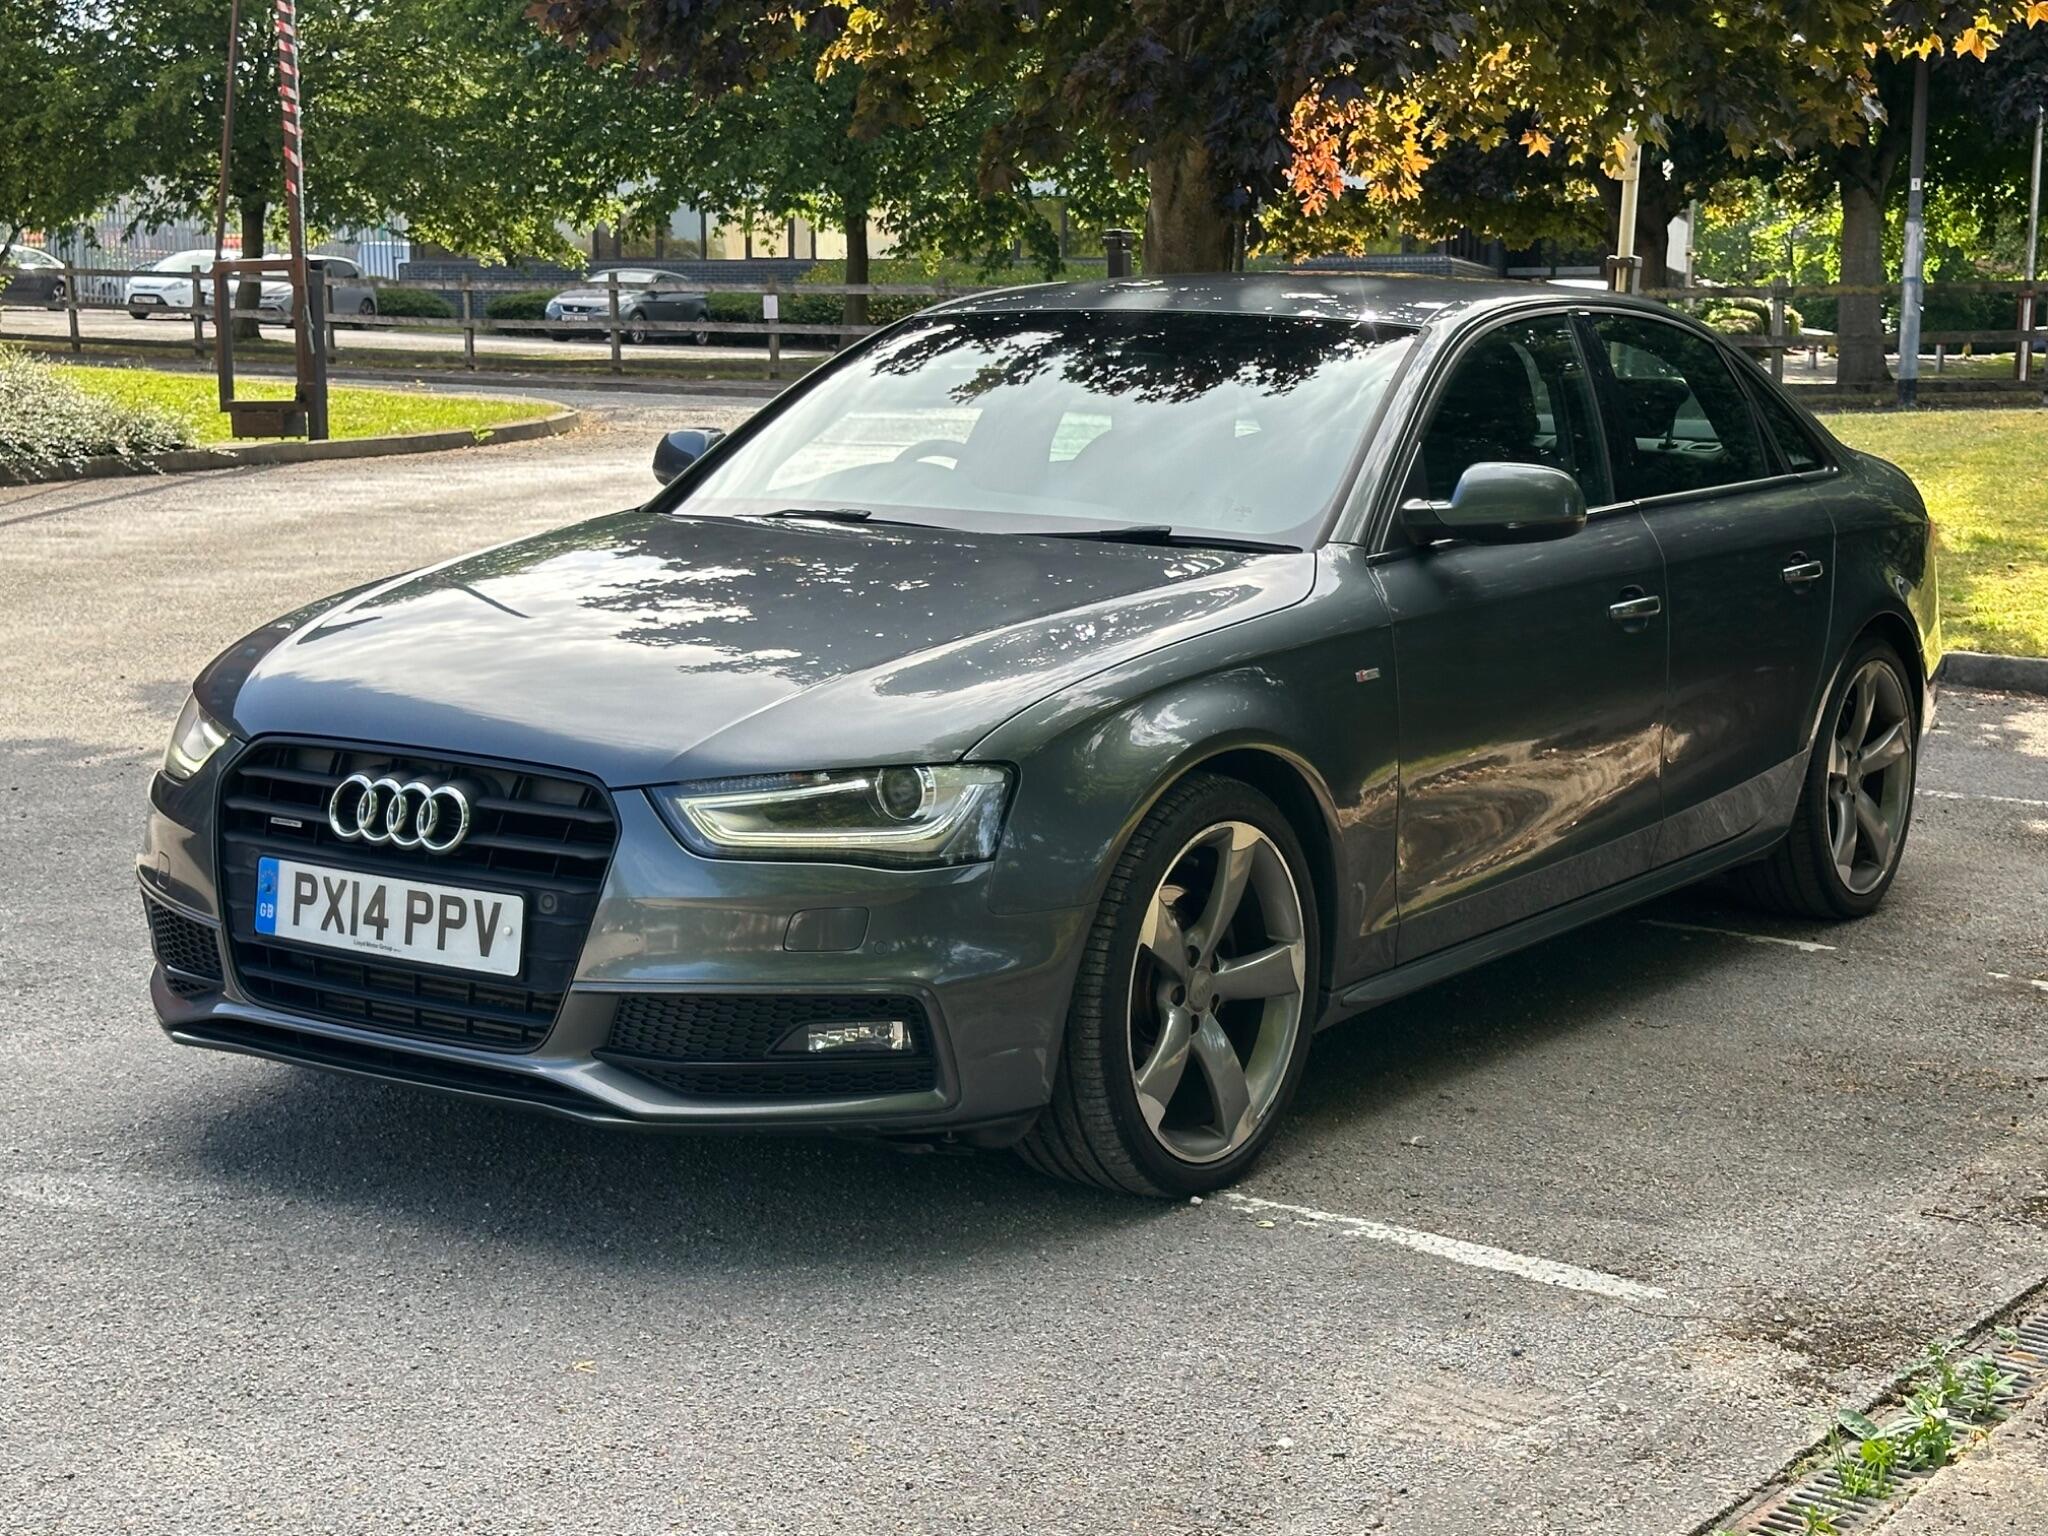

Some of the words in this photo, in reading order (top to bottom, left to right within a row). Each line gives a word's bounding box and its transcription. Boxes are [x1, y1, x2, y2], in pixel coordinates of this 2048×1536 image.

[259, 902, 273, 919] GB
[292, 871, 389, 941] PX14
[404, 889, 502, 958] PPV
